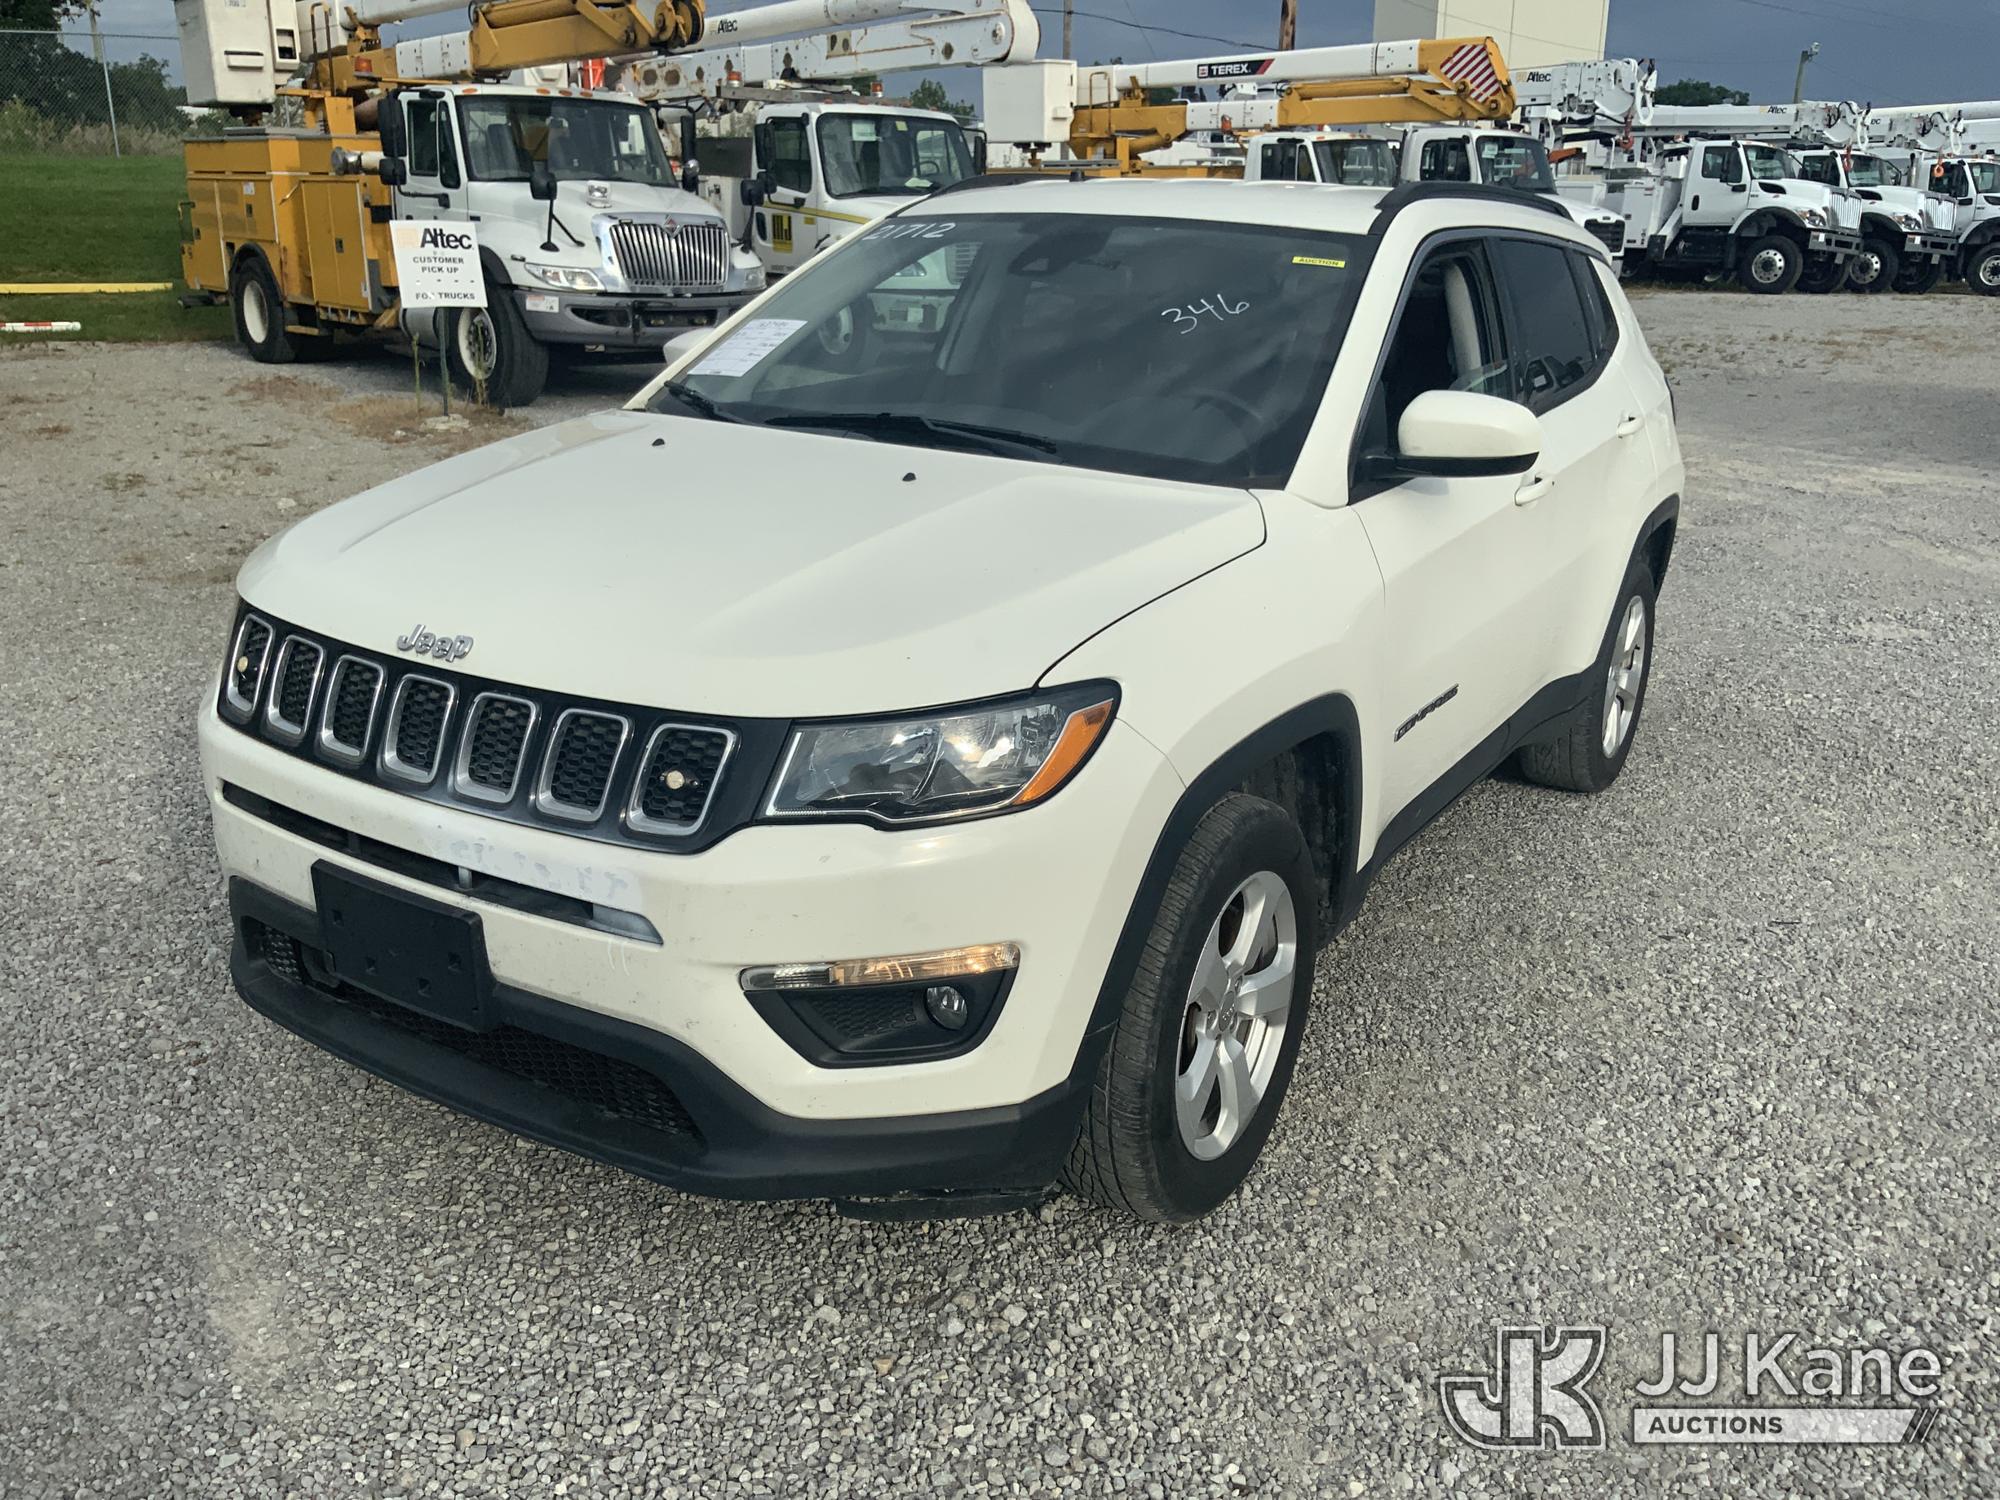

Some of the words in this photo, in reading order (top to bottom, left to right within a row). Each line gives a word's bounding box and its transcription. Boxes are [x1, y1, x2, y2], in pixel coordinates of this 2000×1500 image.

[1211, 63, 1249, 76] TEREX
[1526, 71, 1552, 83] Altec
[420, 227, 473, 249] Altec
[862, 222, 956, 241] 21712
[412, 256, 464, 265] CUSTOMER
[1299, 257, 1340, 267] AUCTION
[437, 292, 476, 300] TRUCKS
[1160, 293, 1250, 335] 346
[396, 623, 474, 663] Jeep
